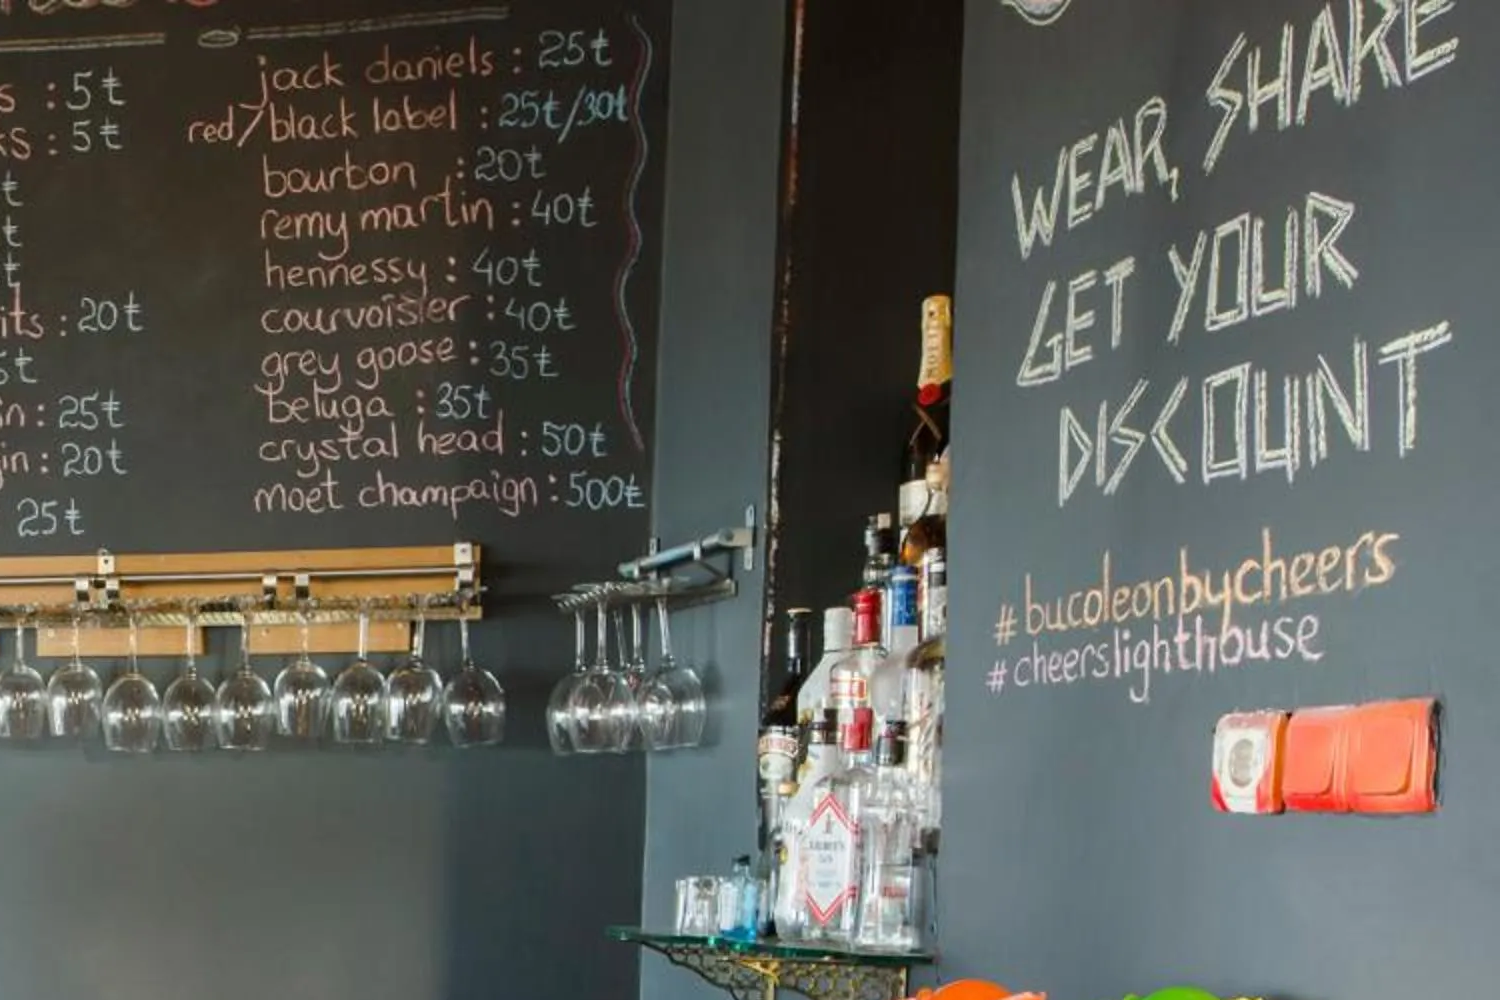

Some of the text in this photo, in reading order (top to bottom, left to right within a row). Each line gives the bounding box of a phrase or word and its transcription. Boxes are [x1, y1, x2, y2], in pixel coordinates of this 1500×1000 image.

[238, 50, 345, 110] jack
[365, 35, 494, 84] daniels
[373, 89, 457, 133] label
[262, 146, 417, 198] bourbon
[260, 207, 350, 261] remy
[360, 176, 494, 231] martin
[264, 248, 427, 298] hennessy
[1016, 257, 1135, 387] GET
[1167, 191, 1358, 346] YOUR
[253, 349, 341, 394] grey
[356, 337, 457, 390] goose
[268, 378, 395, 436] beluga
[1059, 321, 1451, 507] DISCOUNT
[258, 420, 399, 477] crystal
[417, 408, 503, 454] head
[254, 468, 344, 513] moet
[358, 469, 538, 519] champaign
